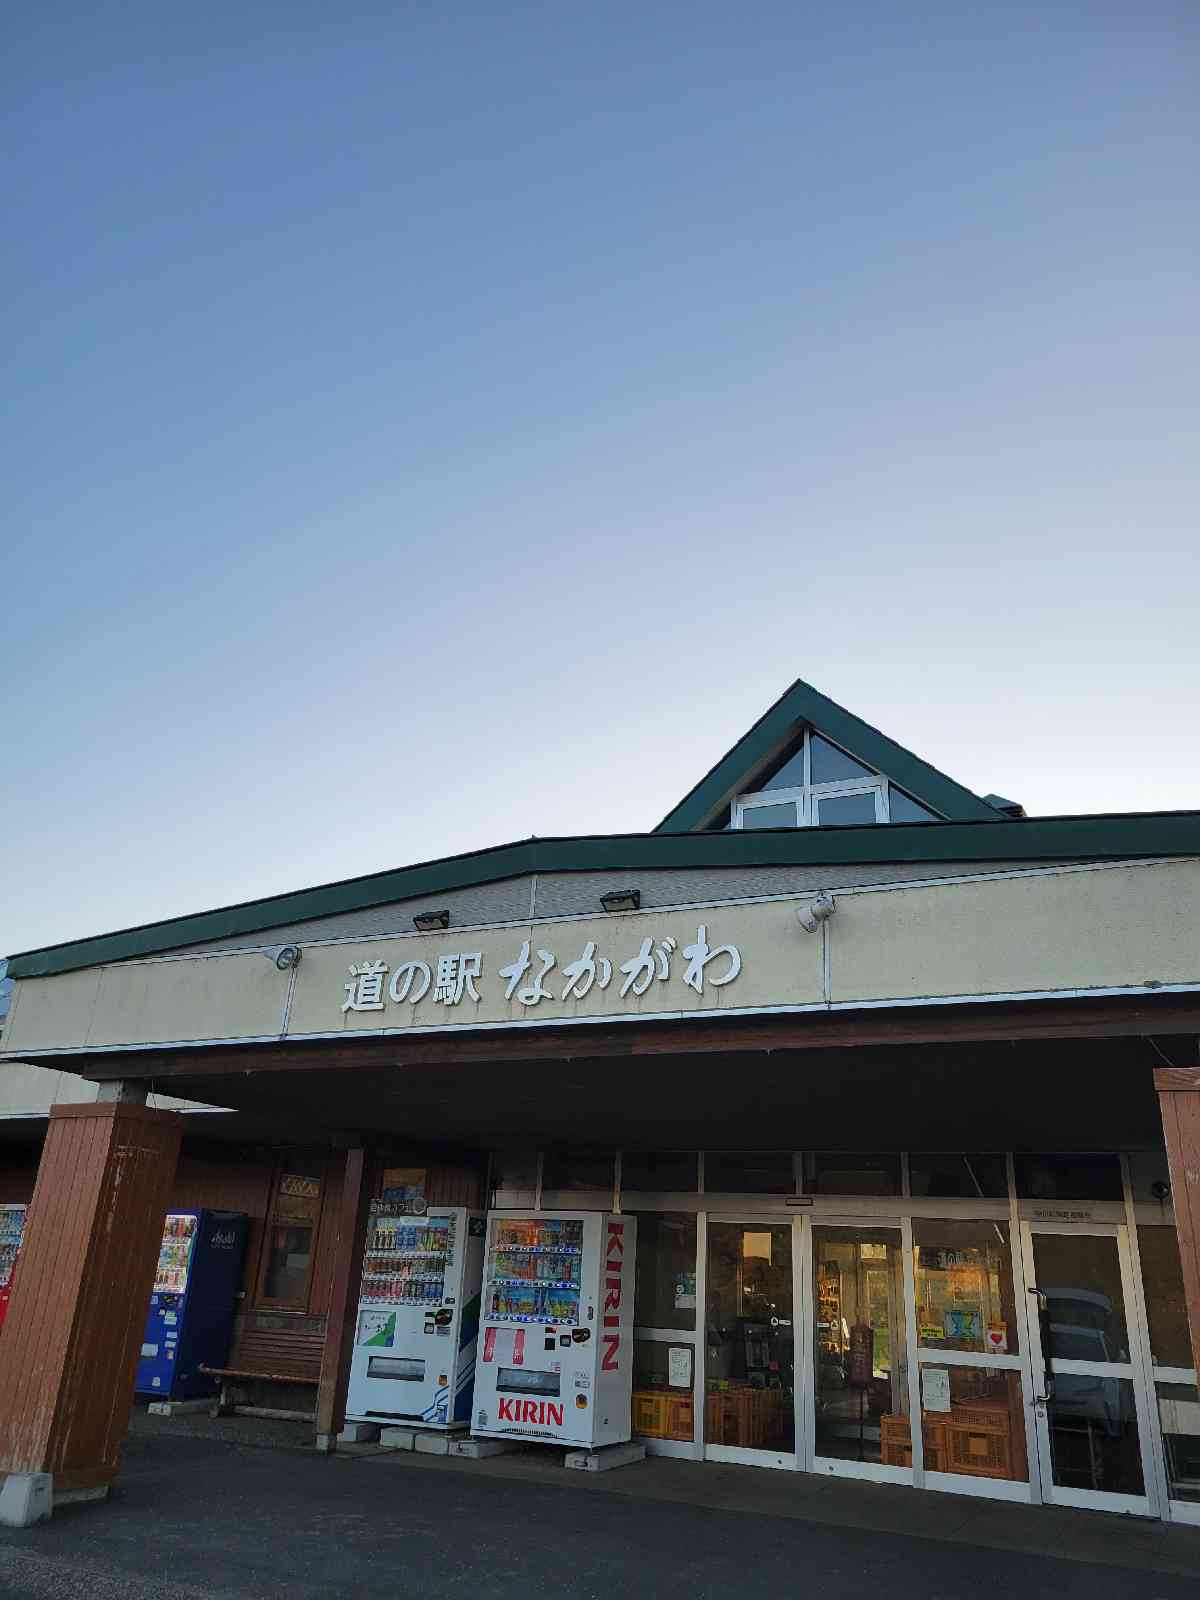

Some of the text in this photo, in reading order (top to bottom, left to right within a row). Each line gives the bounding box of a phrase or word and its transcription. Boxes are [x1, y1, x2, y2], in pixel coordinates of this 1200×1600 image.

[342, 924, 742, 1012] 道の駅 なかがわ
[602, 1223, 624, 1371] KIRIN
[498, 1398, 564, 1426] KIRIN
